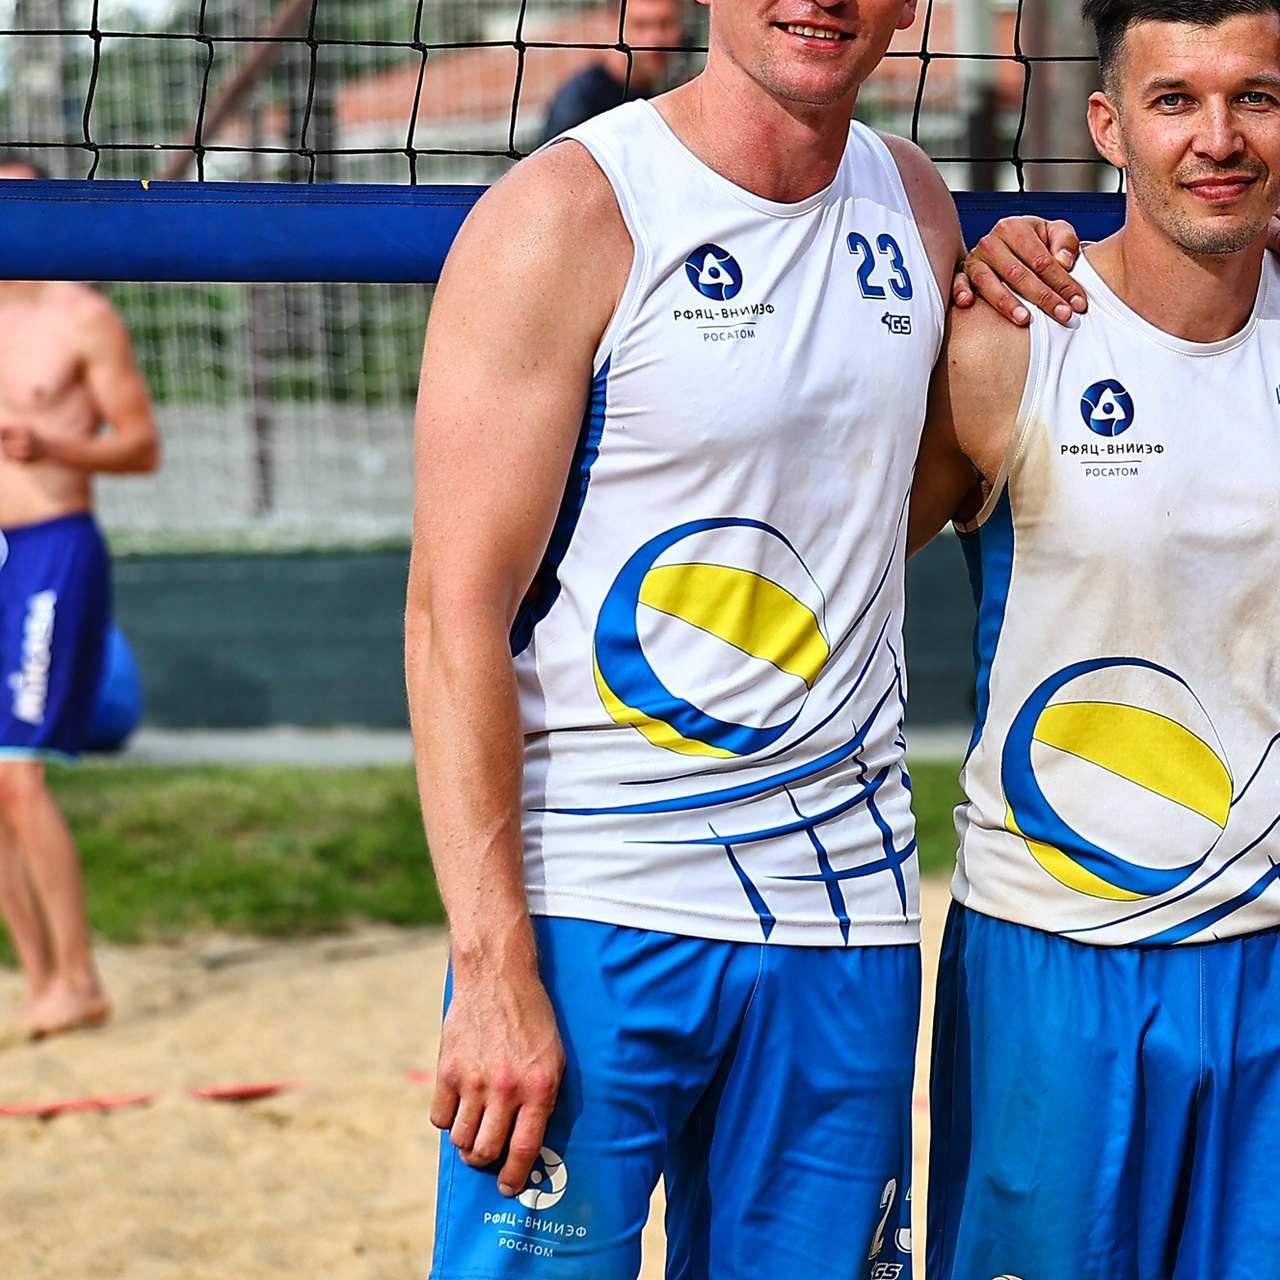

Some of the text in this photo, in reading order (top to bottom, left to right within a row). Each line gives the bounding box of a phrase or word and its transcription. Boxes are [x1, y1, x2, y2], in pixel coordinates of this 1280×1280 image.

[847, 232, 914, 301] 23
[674, 303, 775, 321] РФЯЦ-ВНИИЭФ
[703, 329, 756, 342] РОСАТОМ
[1060, 443, 1165, 456] РФЯЦ-ВНИИЭФ
[1085, 467, 1139, 477] РОСАТОМ
[483, 1212, 587, 1238] РФЯЦ-ВНИИЭФ
[498, 1237, 554, 1258] РОСАТОМ
